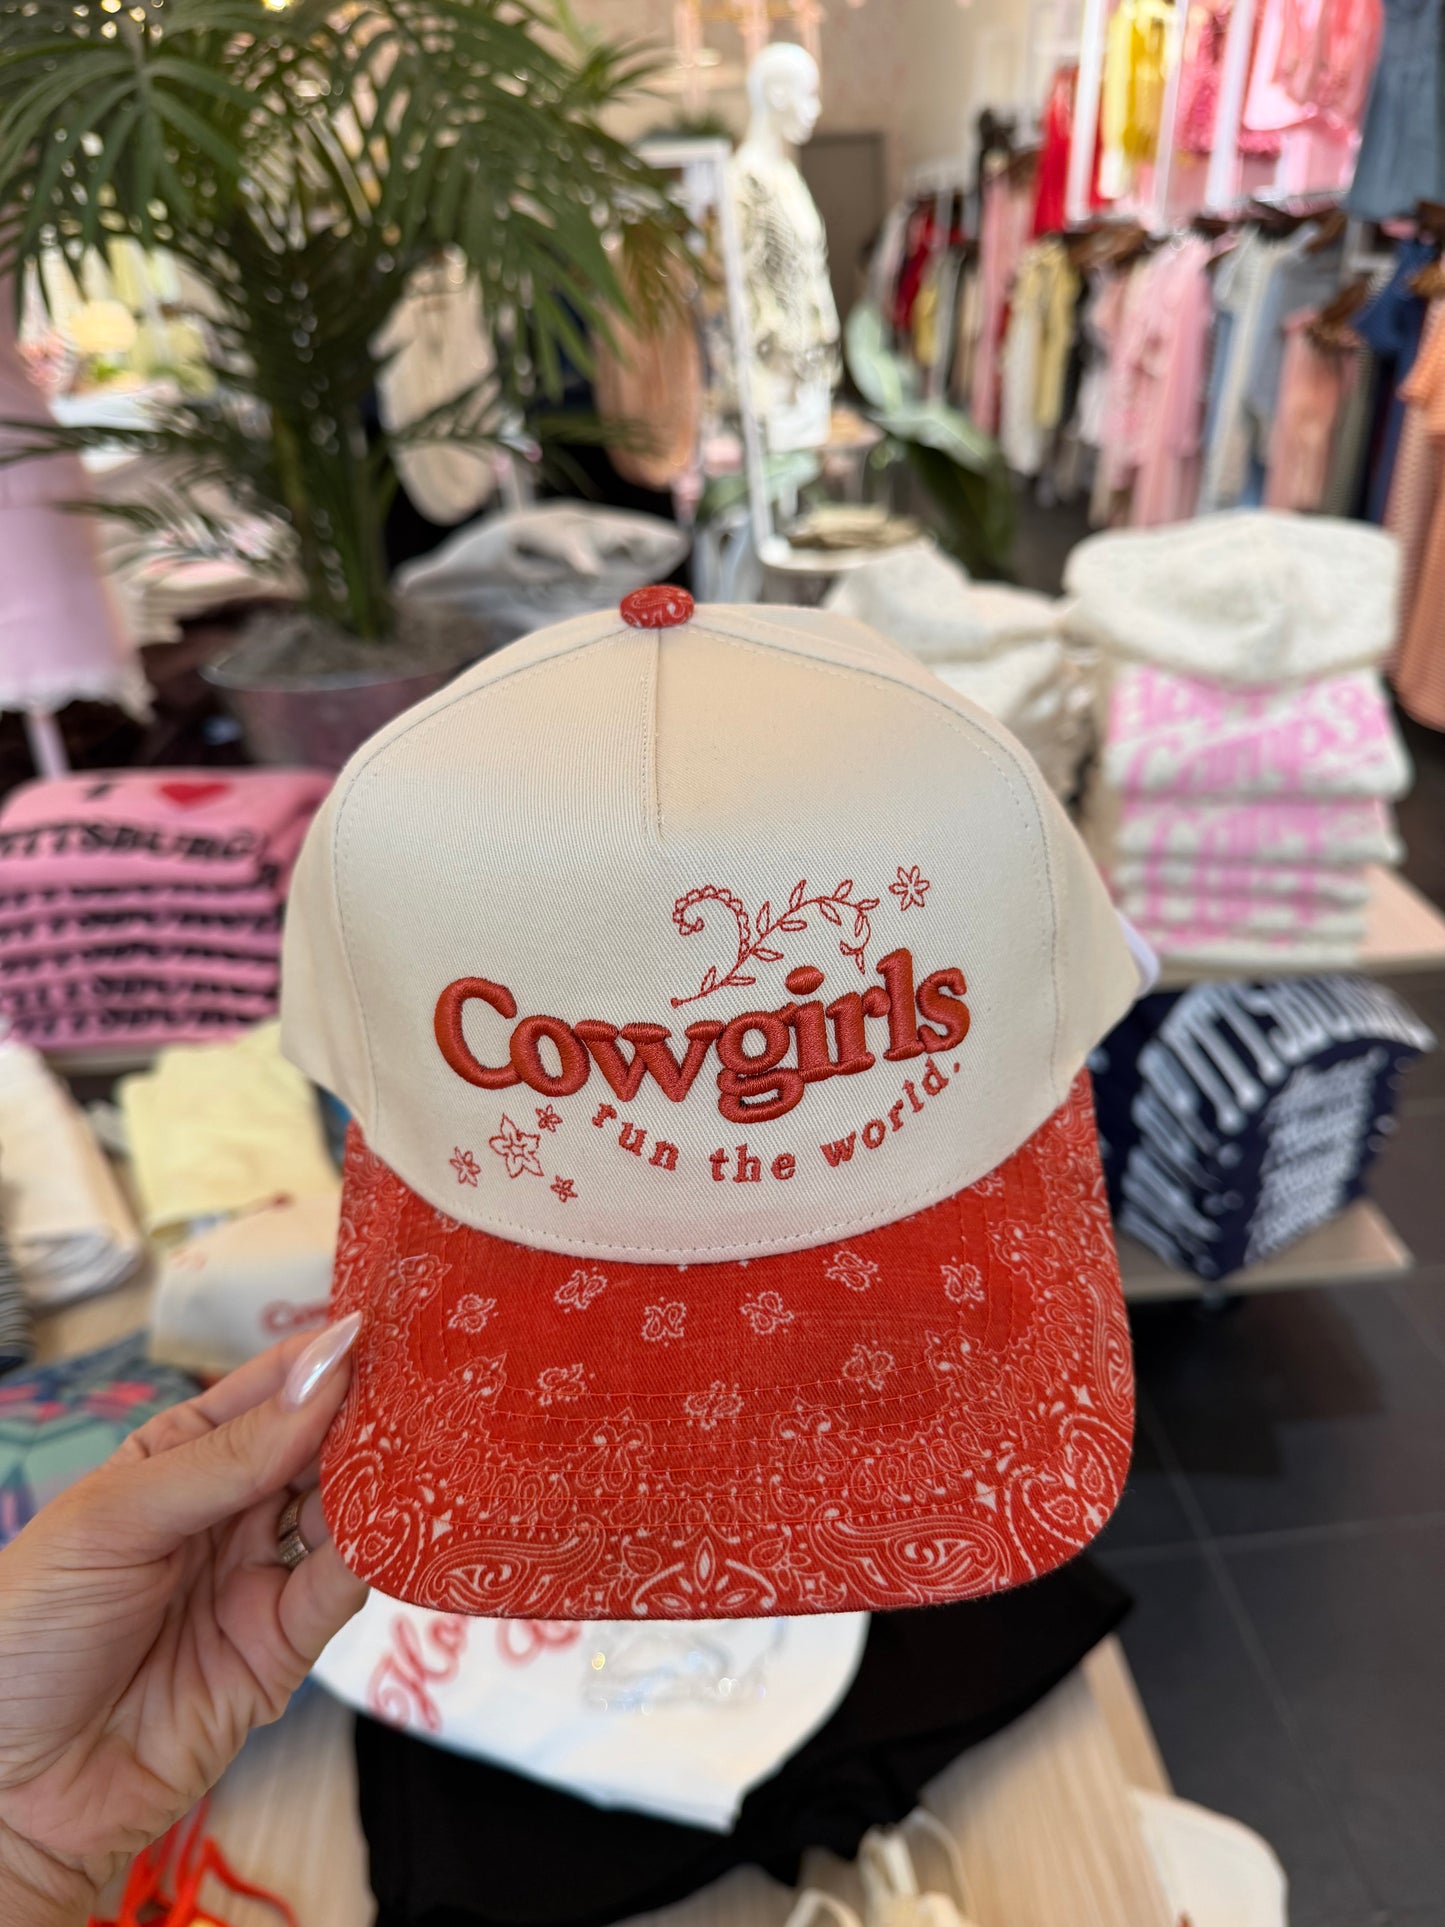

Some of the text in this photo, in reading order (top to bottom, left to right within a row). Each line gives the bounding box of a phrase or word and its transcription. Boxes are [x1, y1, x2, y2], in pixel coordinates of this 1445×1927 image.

[433, 948, 970, 1124] Cowgirls
[592, 1057, 960, 1184] run the world.
